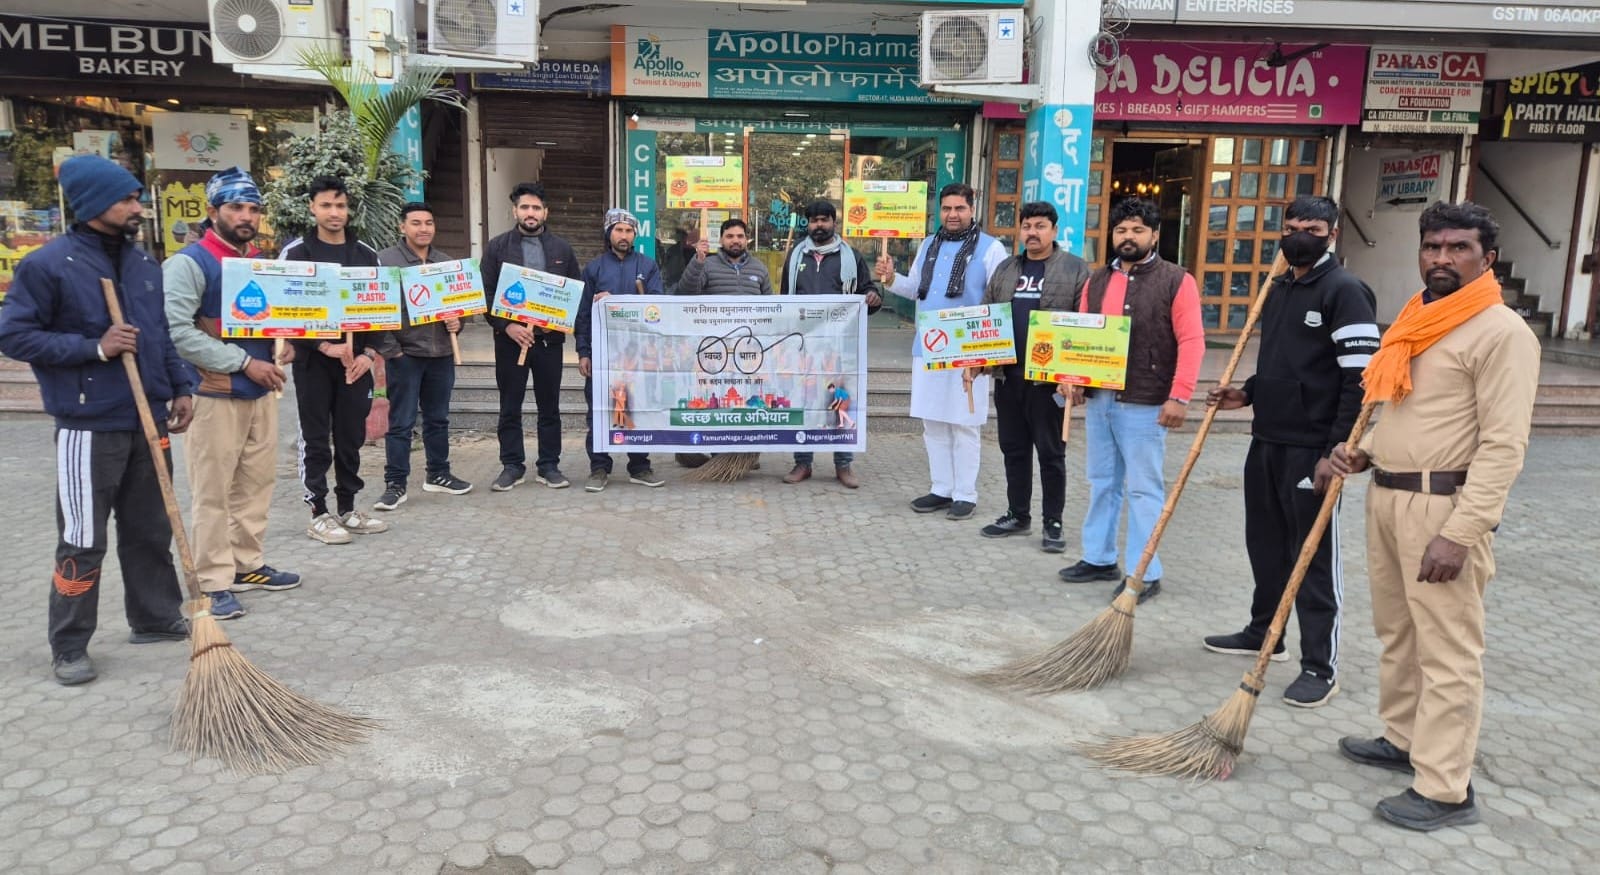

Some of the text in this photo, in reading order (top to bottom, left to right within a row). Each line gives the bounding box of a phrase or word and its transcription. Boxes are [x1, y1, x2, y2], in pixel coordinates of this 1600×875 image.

[1185, 0, 1294, 14] ENTERPRISES
[1493, 7, 1539, 21] GSTIN
[80, 57, 185, 77] BAKERY
[634, 56, 684, 76] Apollo
[1376, 53, 1481, 78] PARAS CA
[653, 70, 701, 80] PHARMACY
[715, 62, 834, 87] अपोलो
[1151, 53, 1316, 97] DELICIA
[669, 79, 702, 89] Druggists
[1510, 72, 1579, 95] SPICY
[1380, 86, 1471, 97] COACHING AVAILABLE FOR
[1399, 98, 1450, 108] CA FOUNDATION
[1127, 103, 1172, 115] BREADS
[1183, 104, 1209, 115] GIFT
[1212, 104, 1267, 117] HAMPERS
[1368, 110, 1424, 121] CA INTERMEDIATE
[1515, 103, 1600, 121] PARTY HALL
[1441, 112, 1469, 122] CA FINAL
[1529, 123, 1585, 135] FIRST FLOOR
[1384, 156, 1438, 175] PARAS CA
[1381, 180, 1434, 197] MY LIBRARY
[166, 196, 202, 218] MB
[444, 272, 473, 284] SAY NO TO
[352, 282, 390, 291] SAY NO TO
[449, 282, 472, 292] PLASTIC
[357, 293, 386, 302] PLASTIC
[683, 306, 698, 315] नगर
[699, 304, 718, 315] निगम
[966, 318, 1002, 330] SAY NO TO
[972, 329, 1000, 339] PLASTIC
[704, 351, 758, 361] स्वच्छ भारत
[681, 408, 790, 424] स्वच्छ भारत अभियान
